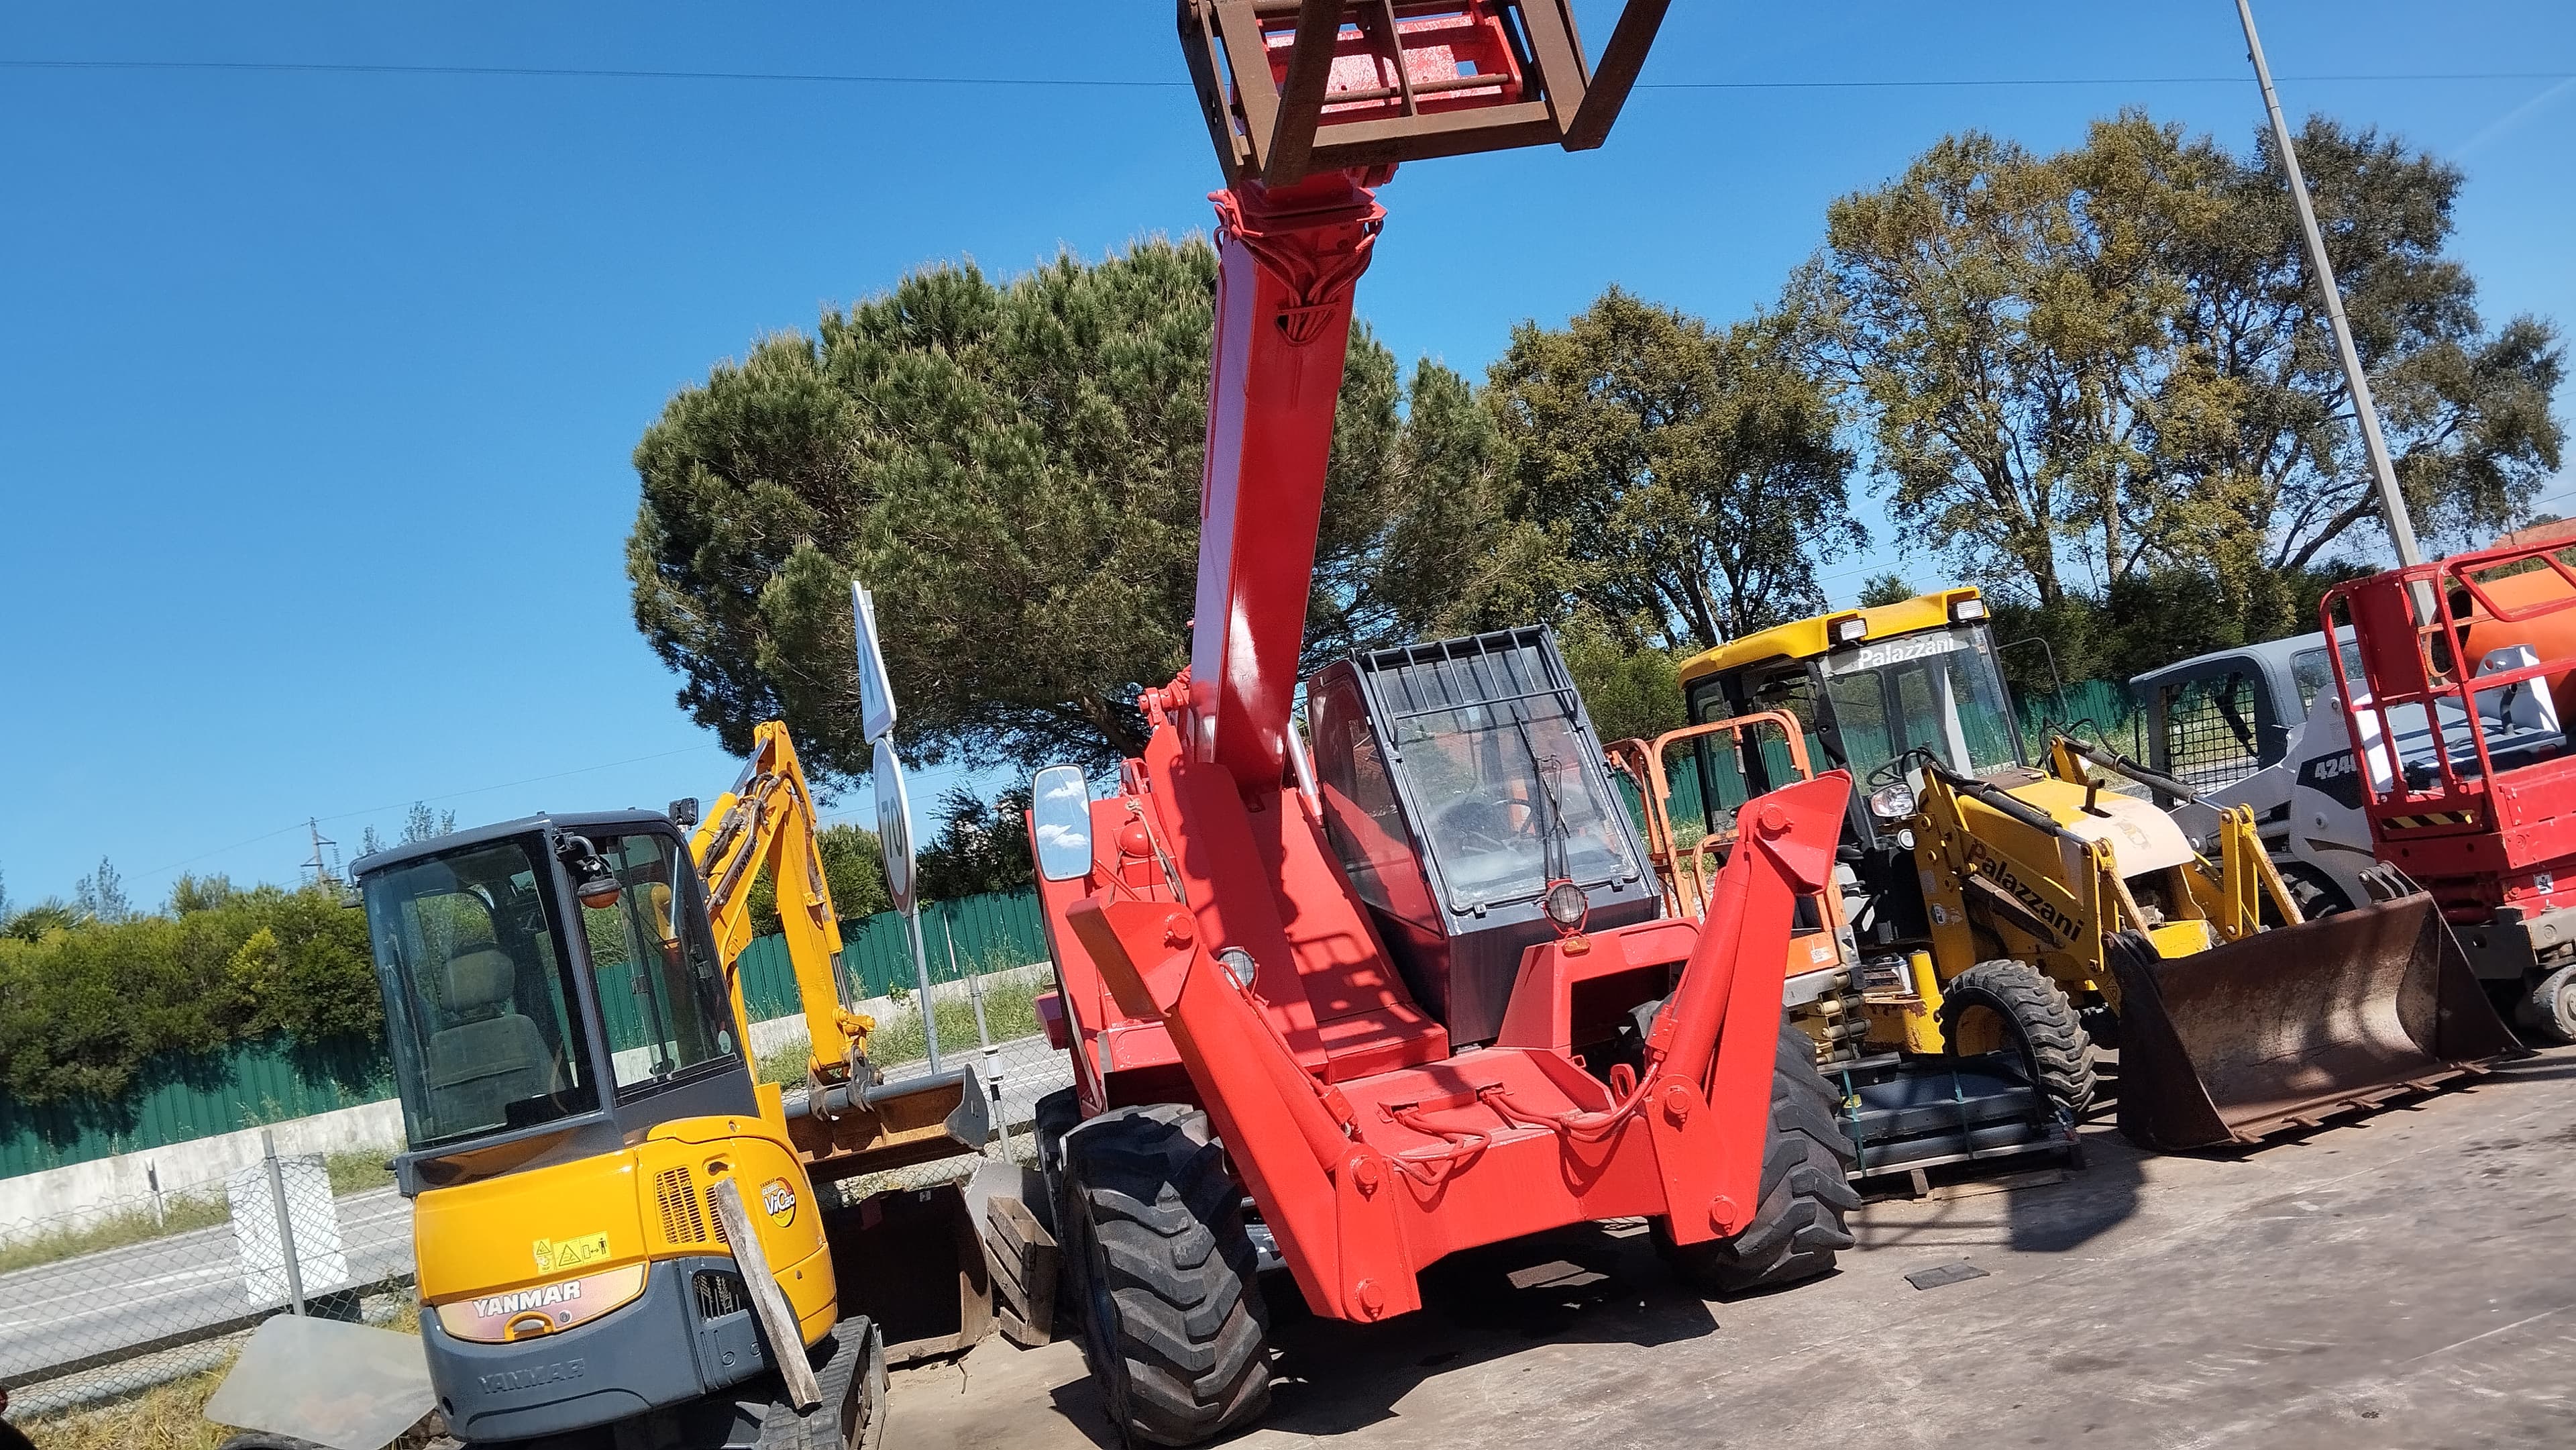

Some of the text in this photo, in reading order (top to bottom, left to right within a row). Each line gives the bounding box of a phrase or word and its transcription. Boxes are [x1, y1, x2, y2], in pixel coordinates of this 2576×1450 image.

[1858, 632, 1954, 670] Palazzani
[881, 796, 903, 858] 70
[734, 836, 757, 880] YANMAR
[1967, 840, 2085, 943] Palazzani
[472, 1280, 582, 1318] YANMAR
[477, 1357, 586, 1394] YANMAR
